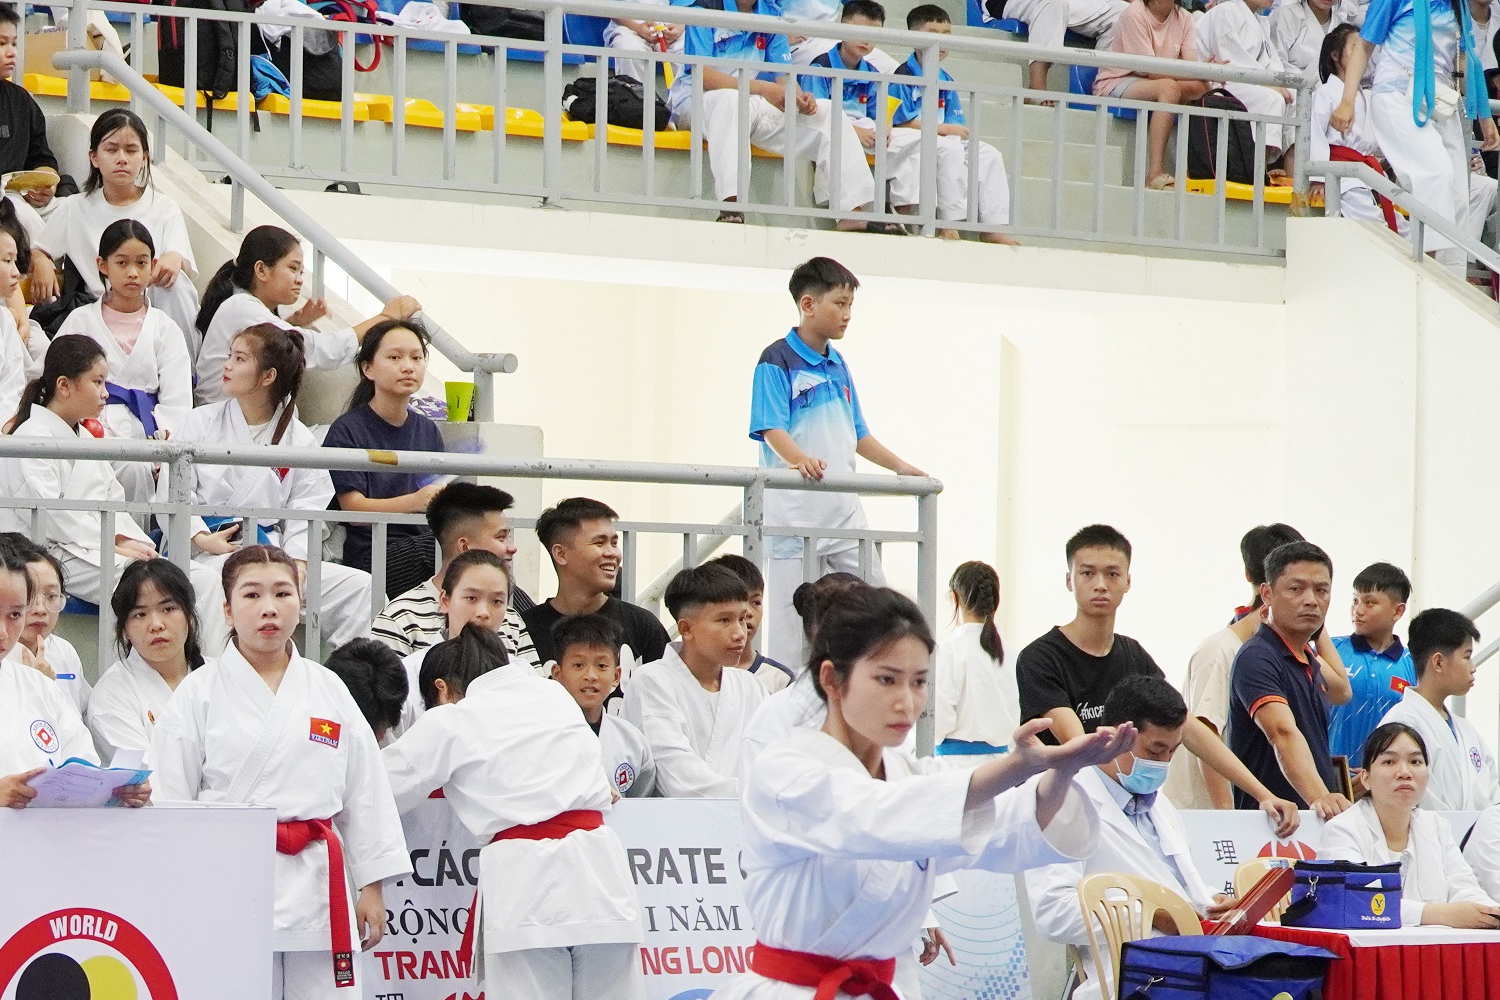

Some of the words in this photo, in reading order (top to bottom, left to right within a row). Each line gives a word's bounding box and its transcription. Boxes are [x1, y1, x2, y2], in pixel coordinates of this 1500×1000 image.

[626, 847, 727, 885] RATE
[49, 914, 119, 942] WORLD
[666, 896, 743, 932] NĂM
[374, 950, 471, 981] TRAN
[640, 945, 683, 976] NG
